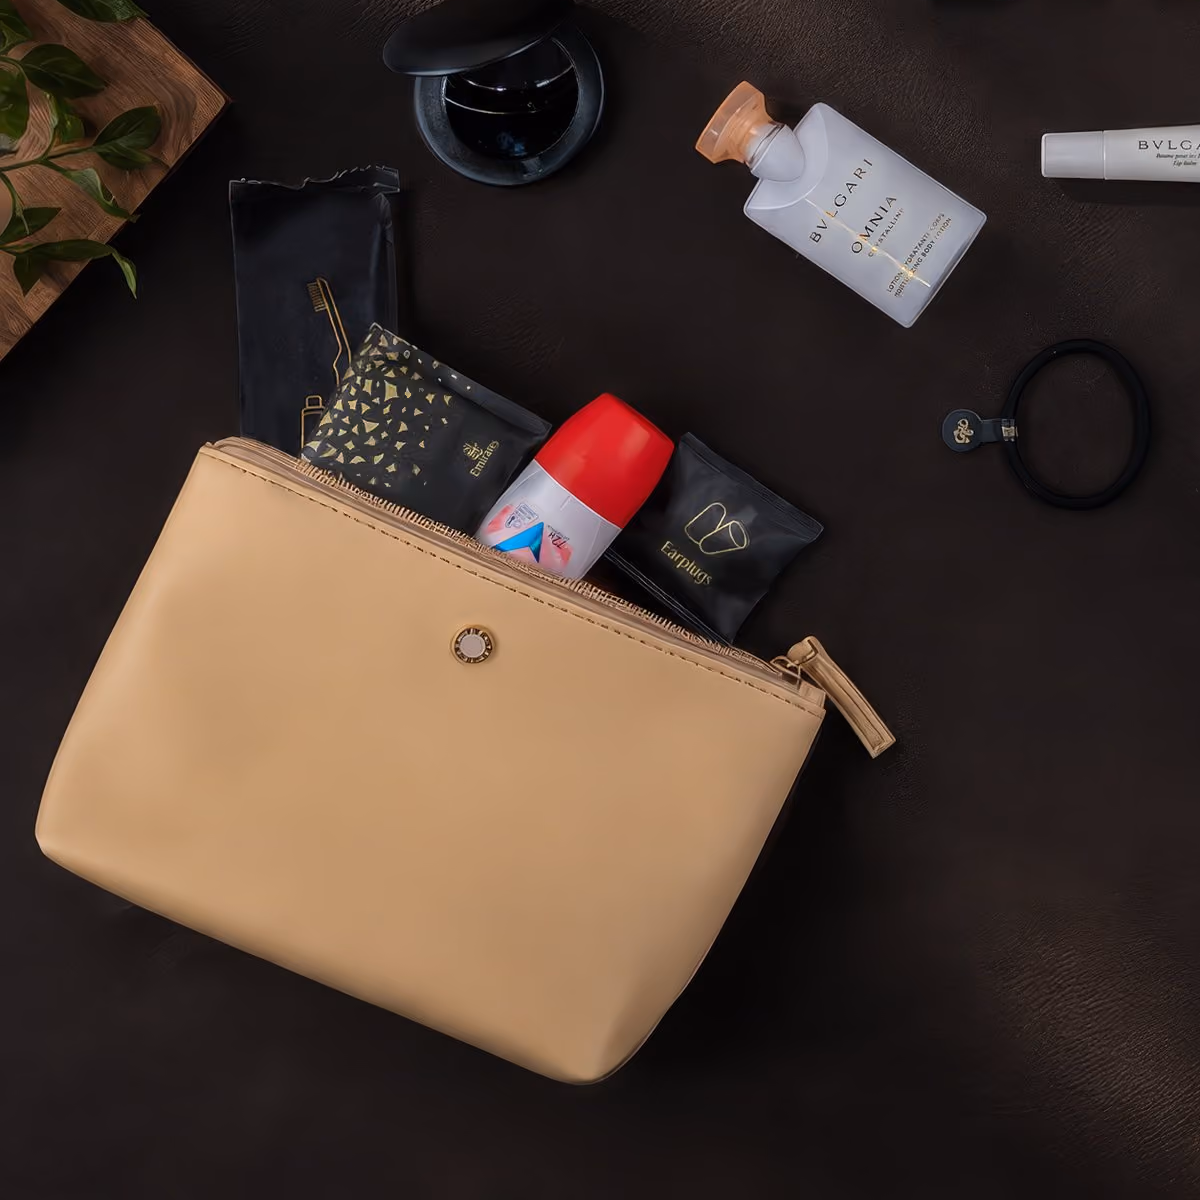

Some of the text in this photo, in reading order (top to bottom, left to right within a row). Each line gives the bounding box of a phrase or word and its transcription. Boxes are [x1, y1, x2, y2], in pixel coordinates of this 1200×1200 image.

[809, 158, 873, 244] BVLGARI
[851, 195, 898, 254] OMNIA
[920, 240, 936, 258] BODY
[660, 540, 713, 585] Earplugs
